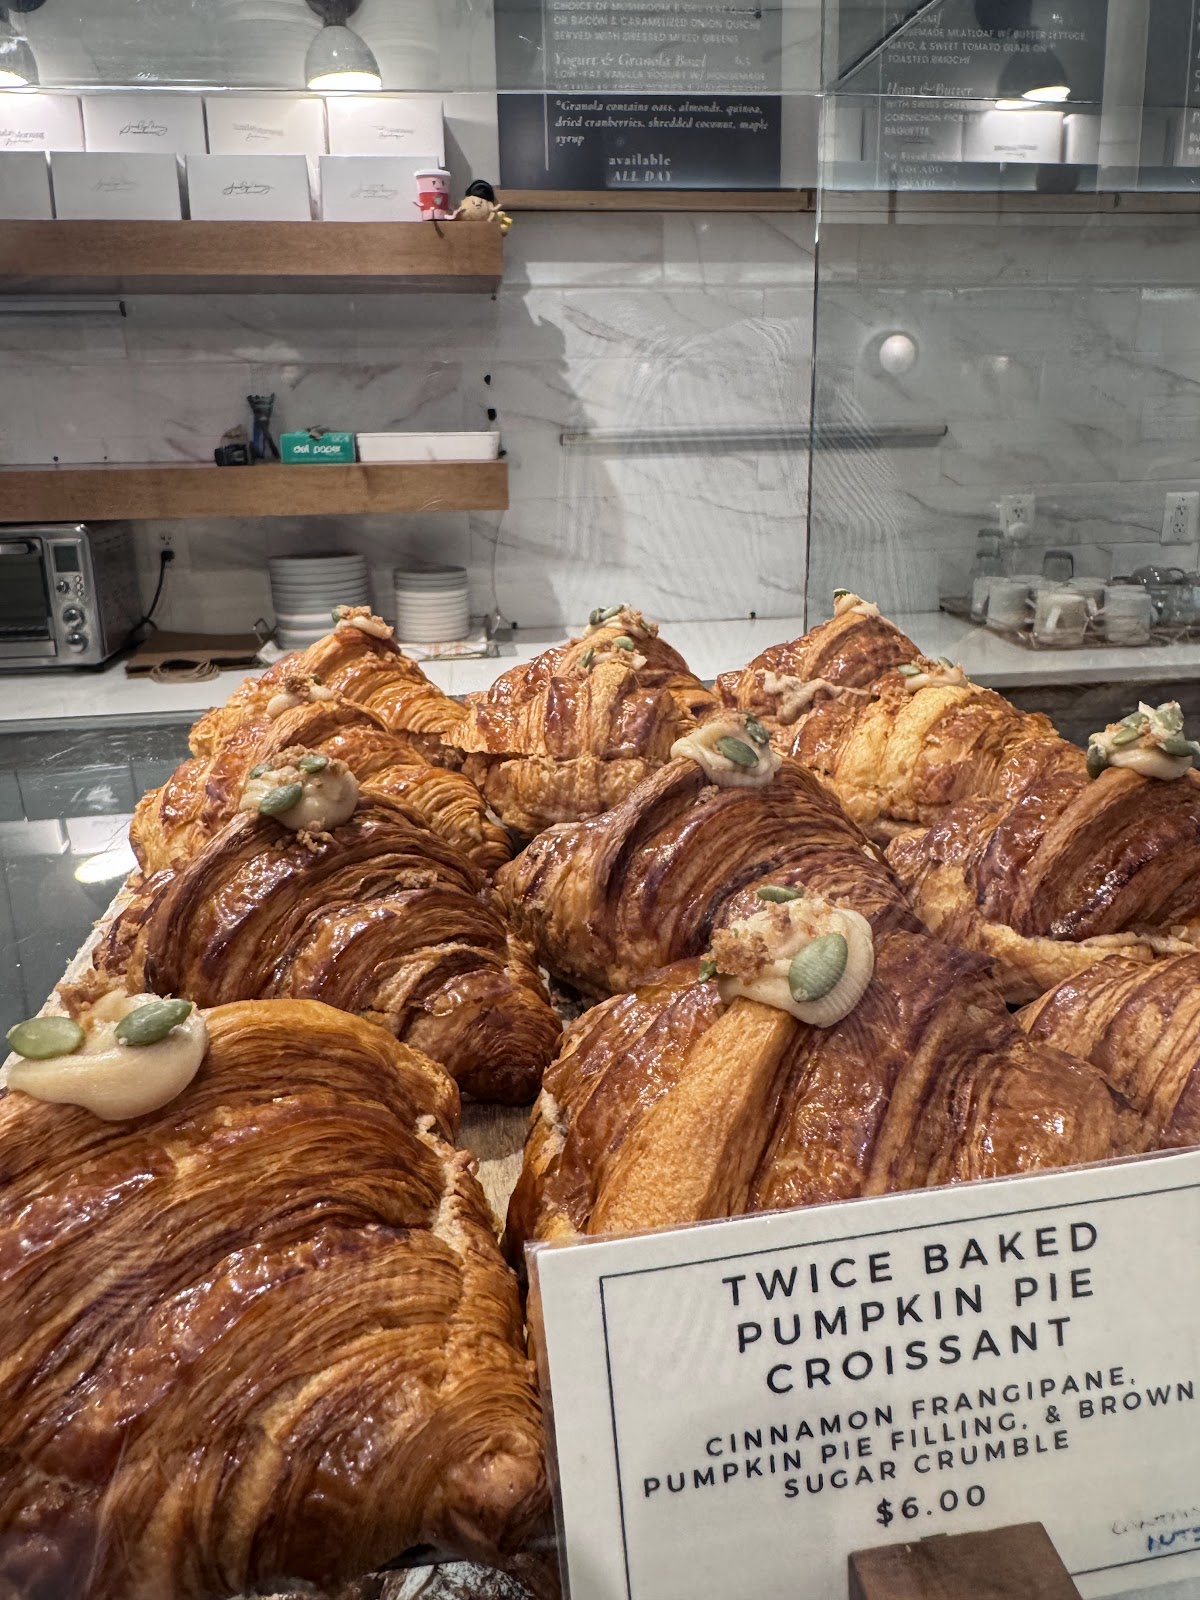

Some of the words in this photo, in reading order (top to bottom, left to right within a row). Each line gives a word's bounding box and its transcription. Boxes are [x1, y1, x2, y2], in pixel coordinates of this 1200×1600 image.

[555, 116, 583, 127] dried
[647, 117, 694, 128] shredded
[739, 118, 769, 132] maple
[606, 102, 650, 111] contains
[555, 135, 586, 147] syrup
[608, 153, 673, 166] available
[613, 170, 637, 182] ALL
[644, 170, 672, 182] DAY
[722, 1252, 893, 1306] TWICE
[924, 1223, 1097, 1274] BAKED
[738, 1284, 983, 1354] PUMPKIN
[1015, 1268, 1094, 1307] PIE
[766, 1316, 1071, 1394] CROISSANT
[643, 1450, 802, 1498] PUMPKIN
[822, 1436, 874, 1464] PIE
[892, 1412, 1029, 1451] FILLING,
[1045, 1405, 1061, 1424] &
[1078, 1380, 1195, 1419] BROWN
[706, 1405, 893, 1457] CINNAMON
[912, 1366, 1136, 1420] FRANGIPANE,
[784, 1460, 896, 1499] SUGAR
[914, 1429, 1069, 1474] CRUMBLE
[876, 1484, 987, 1528] $6.00
